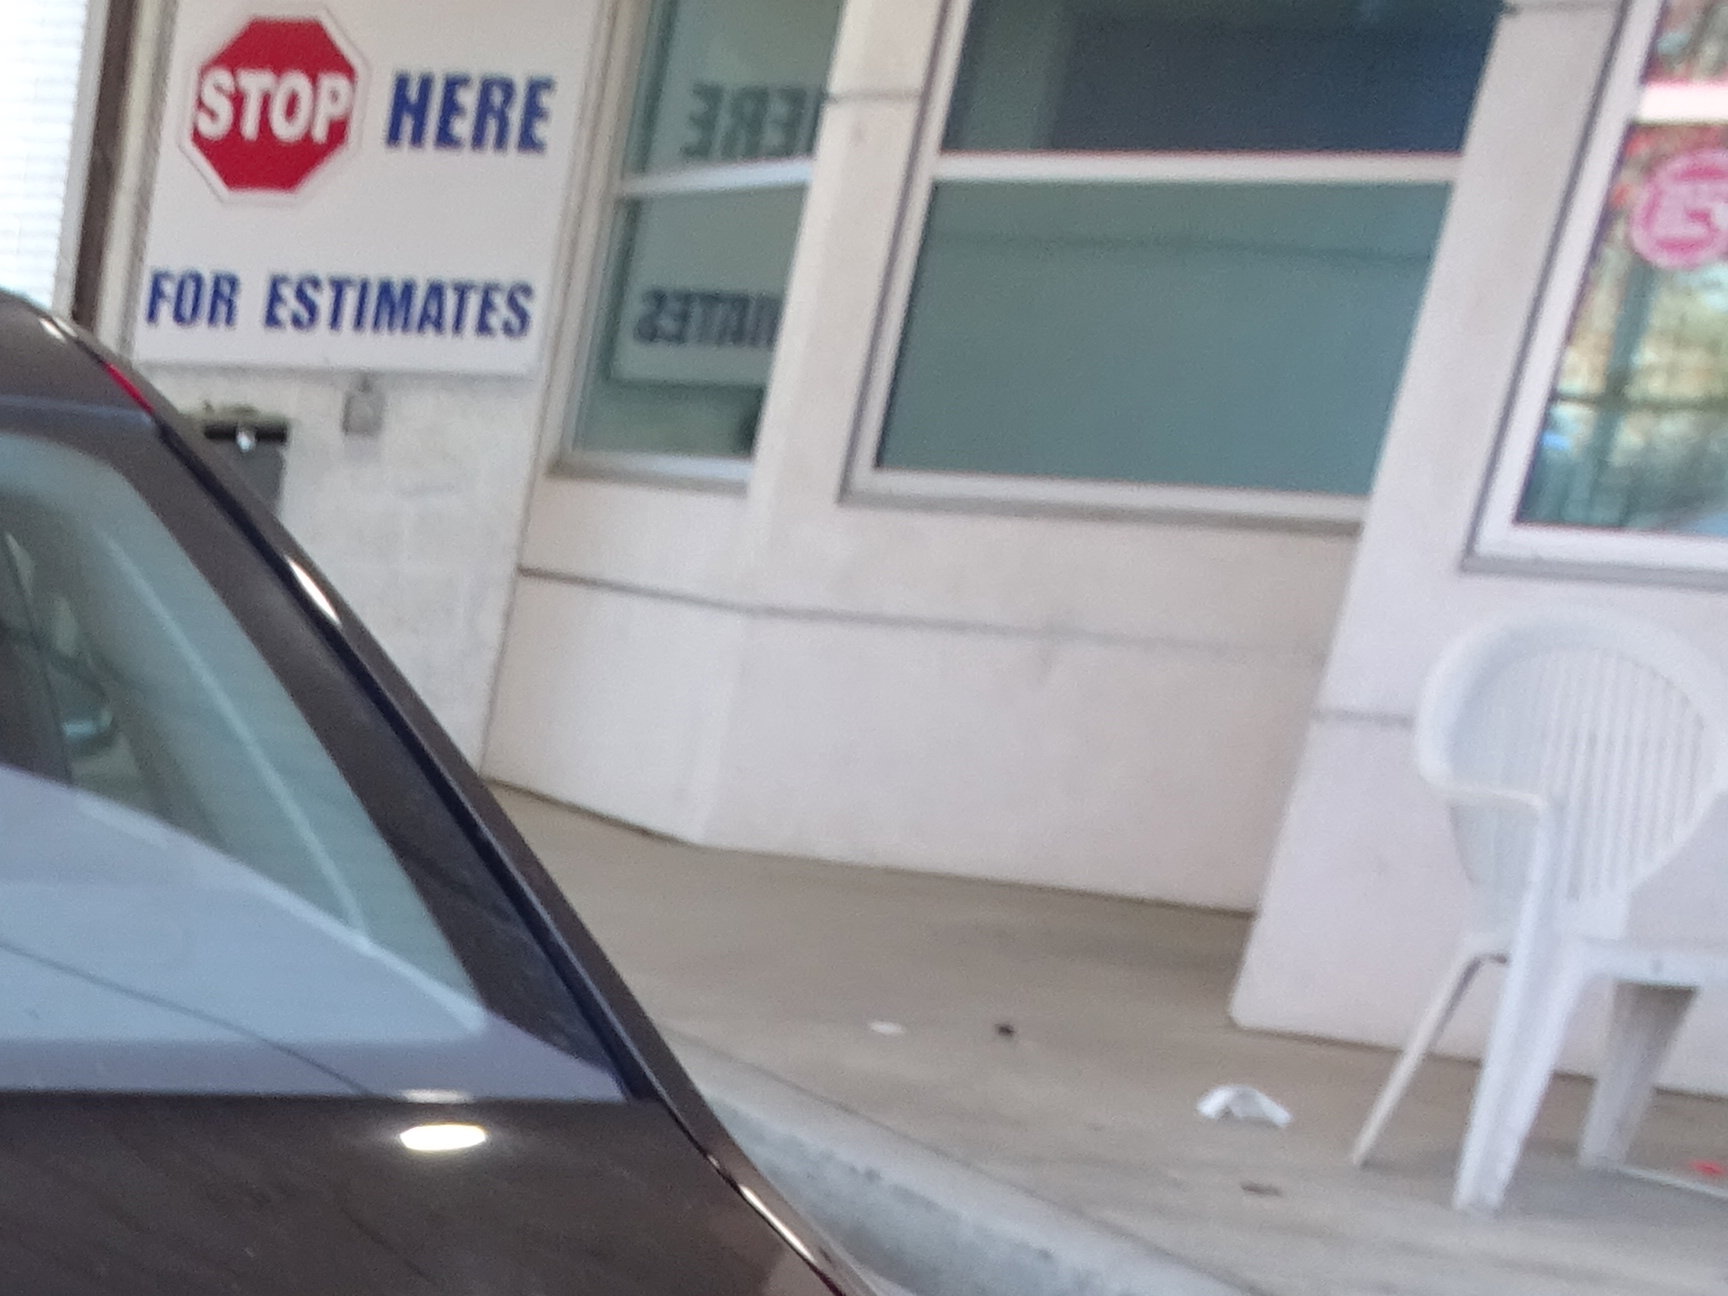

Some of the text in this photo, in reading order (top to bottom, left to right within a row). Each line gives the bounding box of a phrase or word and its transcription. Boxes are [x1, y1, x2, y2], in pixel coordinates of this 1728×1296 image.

[195, 67, 556, 154] STOP HERE
[145, 267, 535, 341] FOR ESTIMATES
